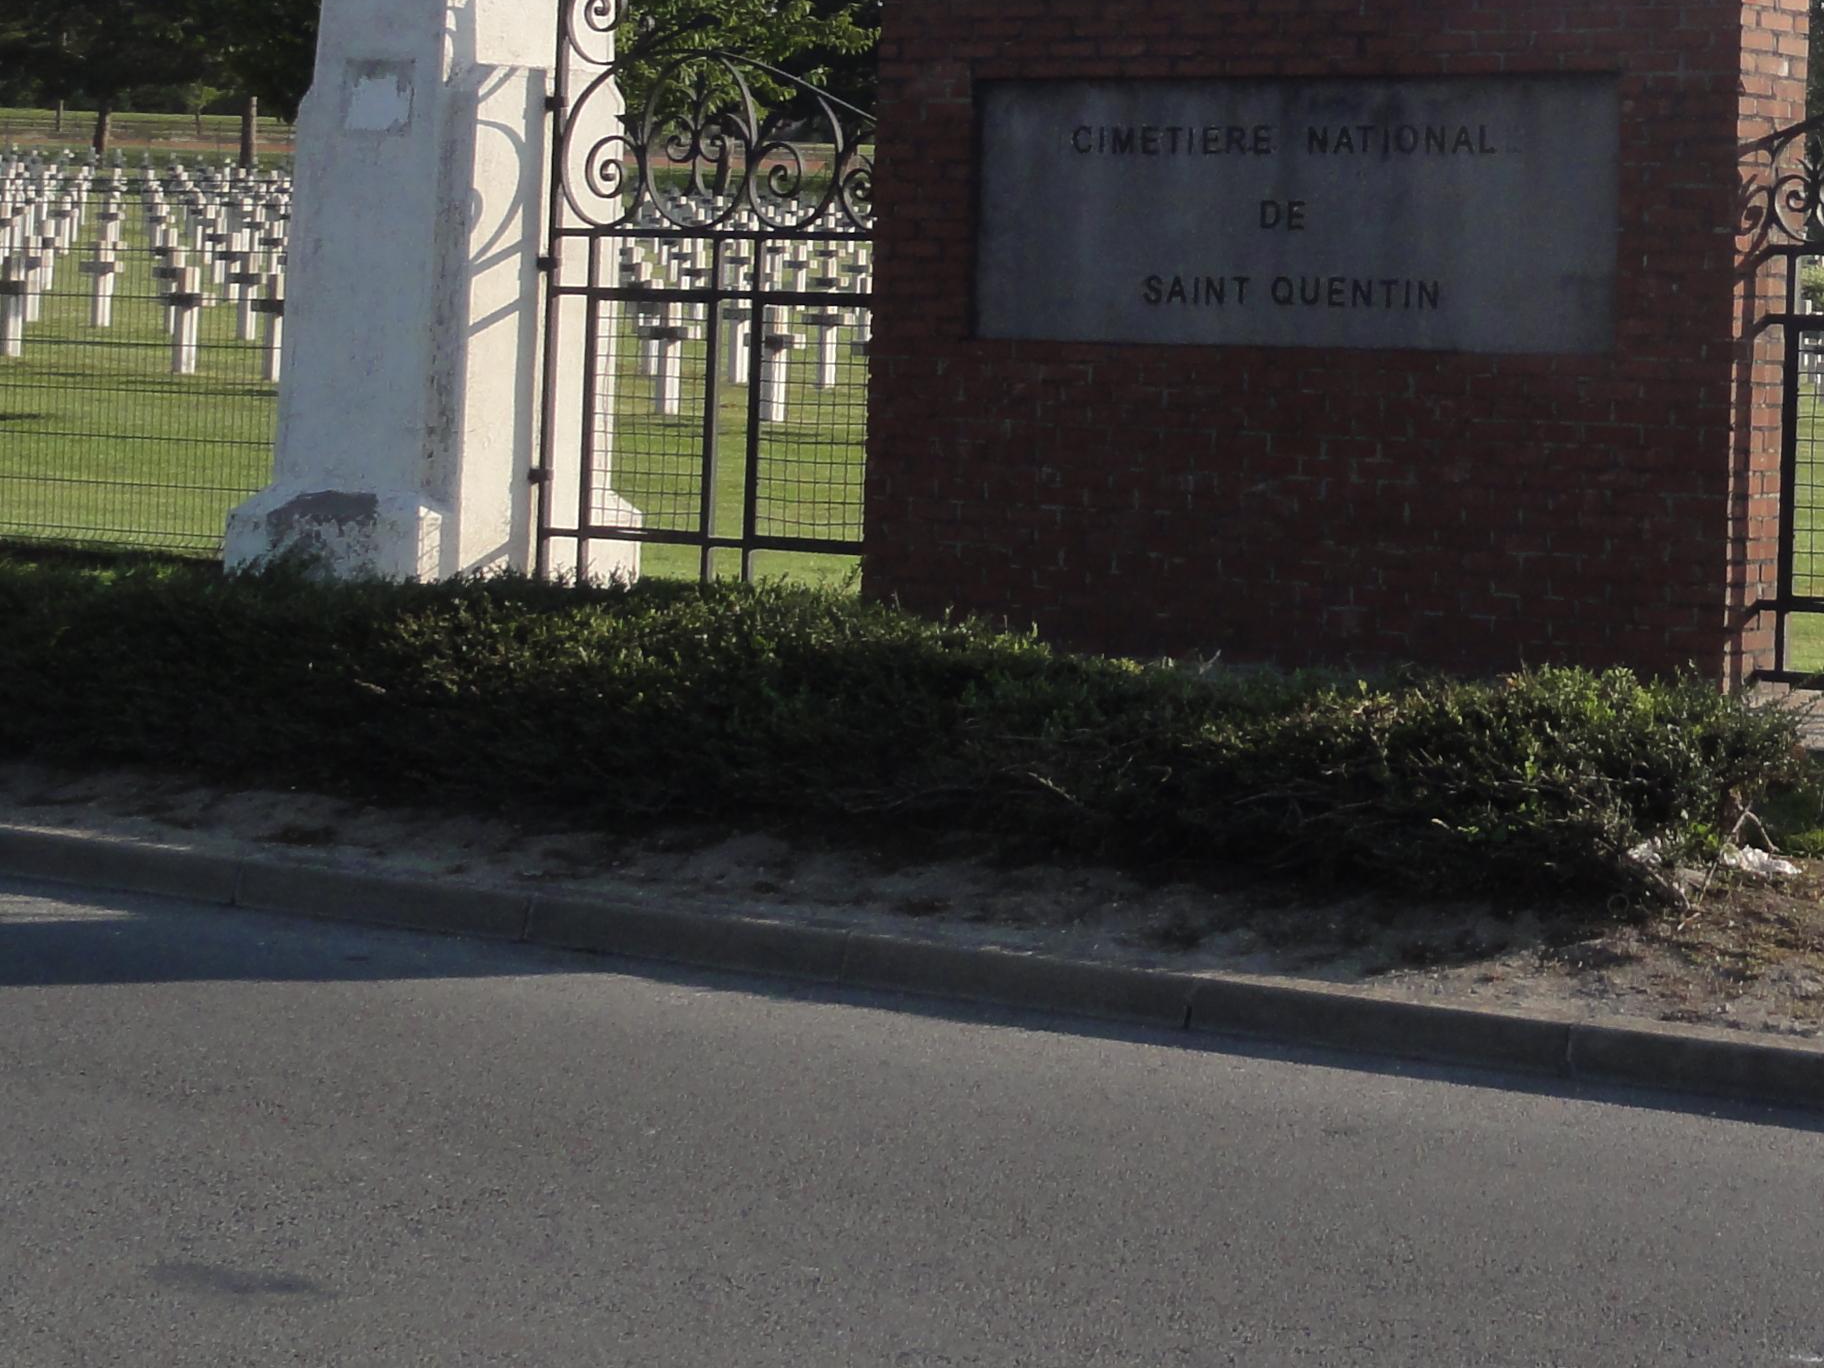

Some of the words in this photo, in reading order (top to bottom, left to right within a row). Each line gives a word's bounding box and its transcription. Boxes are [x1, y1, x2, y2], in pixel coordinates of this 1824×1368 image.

[1071, 125, 1272, 155] CIMETIERE
[1306, 124, 1496, 157] NATIONAL
[1260, 199, 1307, 230] DE
[1143, 275, 1250, 306] SAINT
[1271, 276, 1441, 310] QUENTIN
